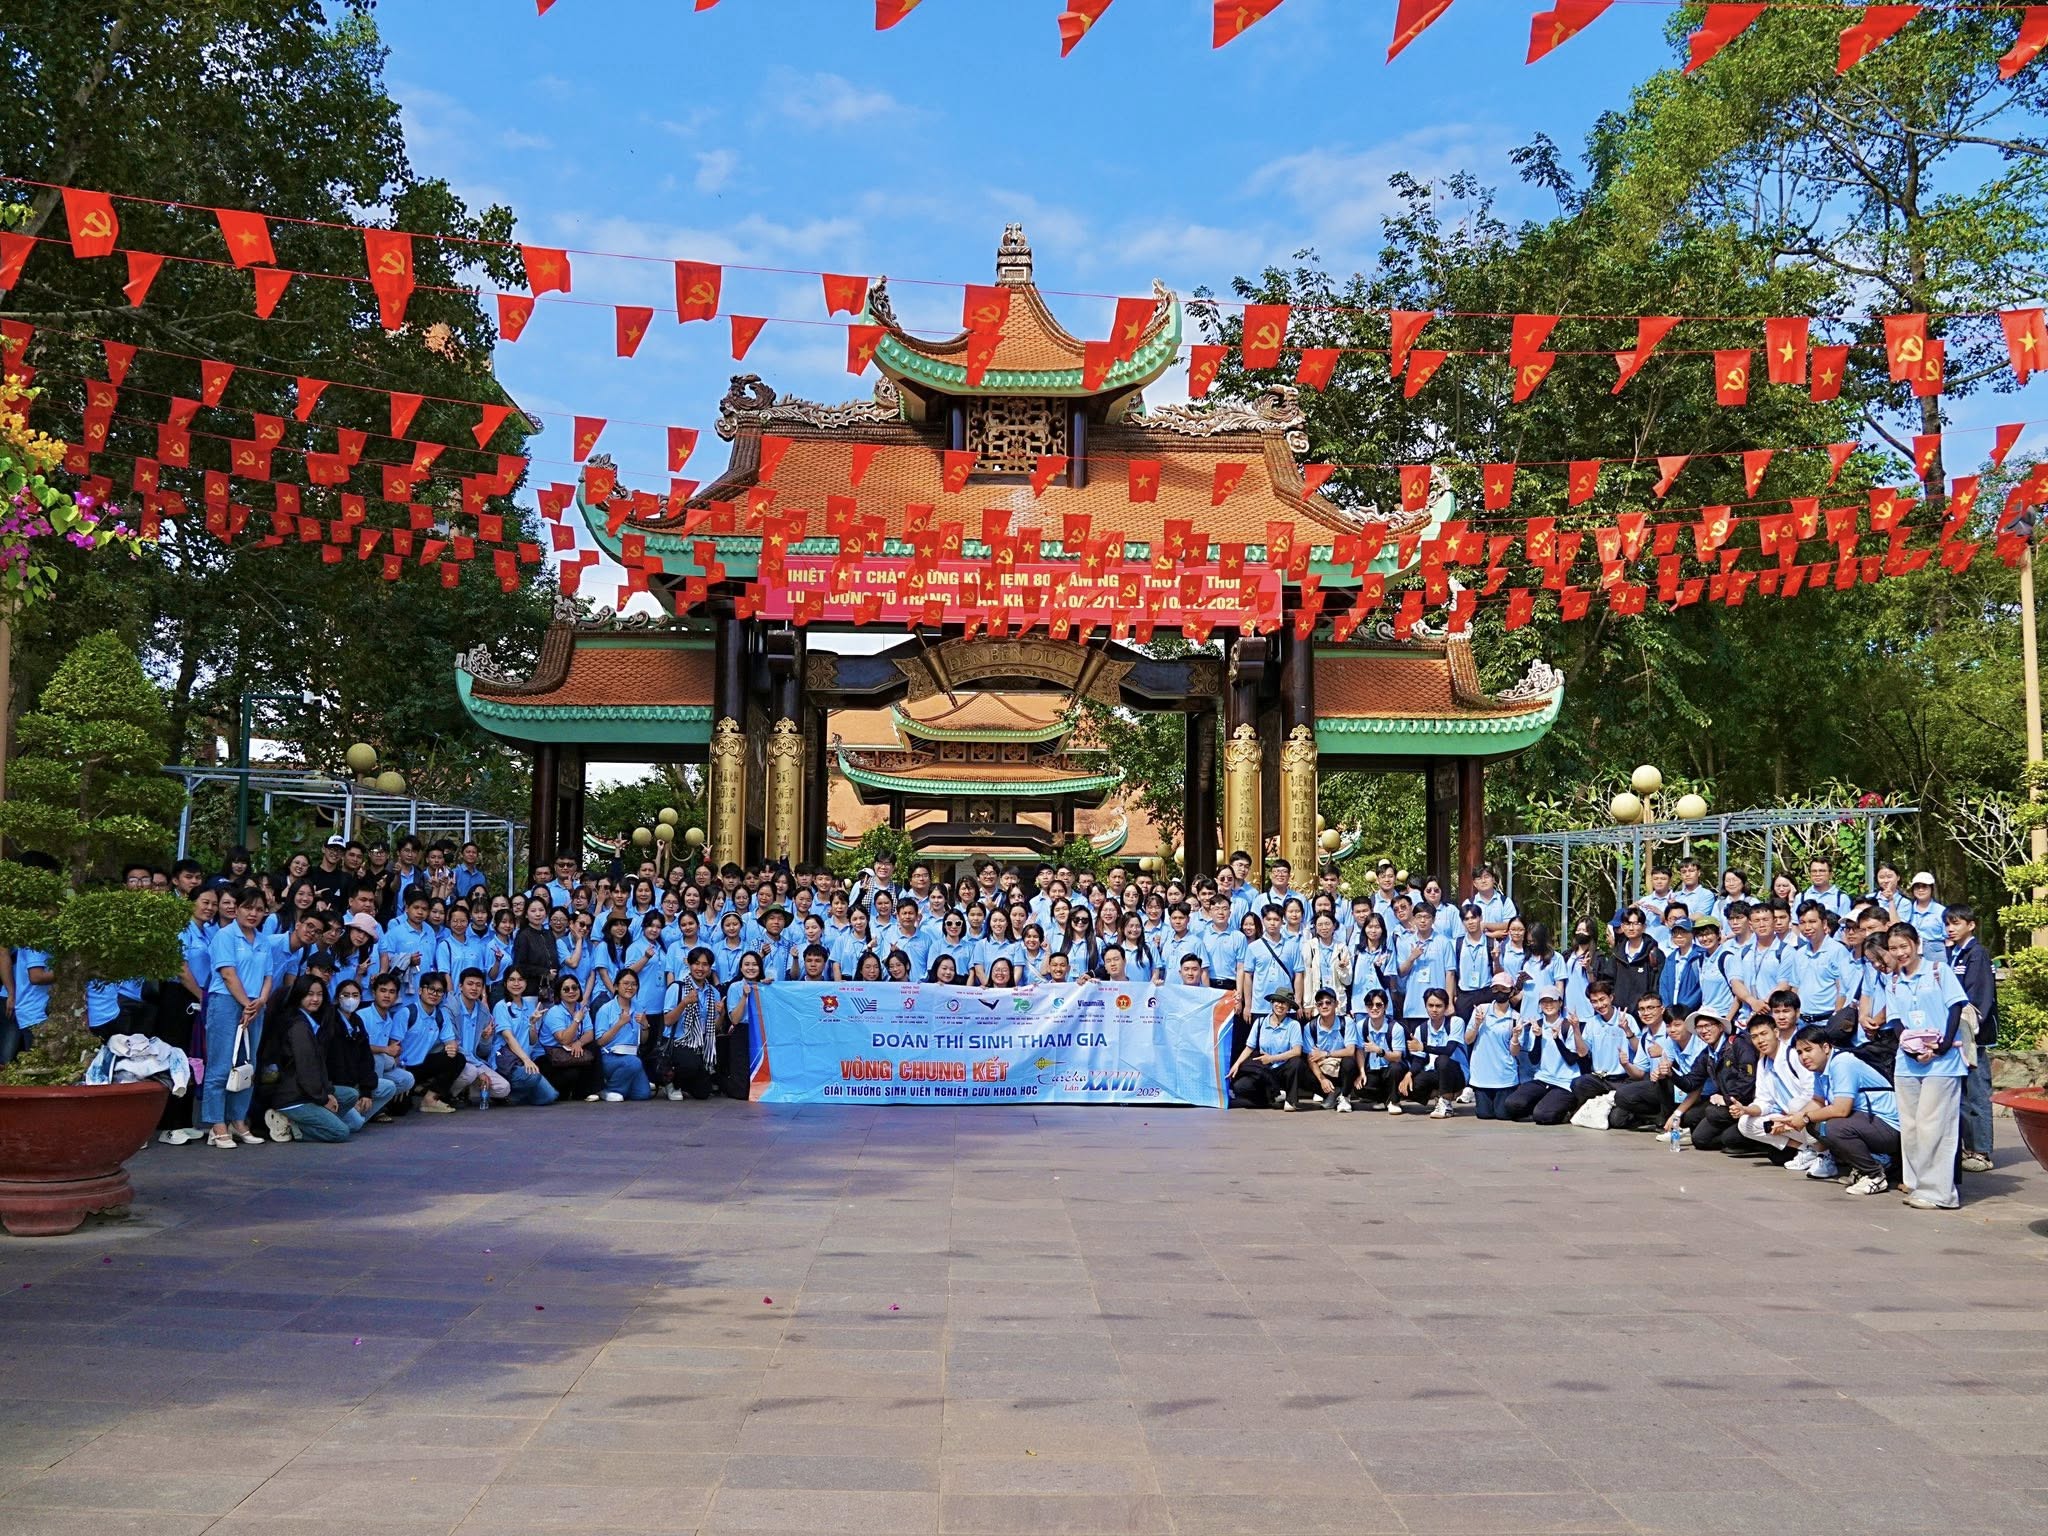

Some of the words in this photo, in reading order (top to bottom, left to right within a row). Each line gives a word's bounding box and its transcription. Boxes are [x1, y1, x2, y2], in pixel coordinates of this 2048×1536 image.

[926, 568, 960, 585] ỪNG
[1000, 572, 1029, 588] IỆM
[1033, 573, 1051, 587] 80
[1040, 594, 1049, 608] 7
[871, 1031, 929, 1049] ĐOÀN
[934, 1032, 964, 1049] THÍ
[968, 1034, 1013, 1049] SINH
[1018, 1033, 1072, 1048] THAM
[1076, 1032, 1108, 1047] GIA
[840, 1056, 893, 1081] VÒNG
[898, 1060, 966, 1082] CHUNG
[971, 1056, 1010, 1083] KẾT
[1081, 1071, 1141, 1091] XXVII
[884, 1086, 907, 1097] SINH
[909, 1084, 931, 1097] VIÊN
[934, 1084, 969, 1097] NGHIÊN
[993, 1087, 1018, 1097] KHOA
[1136, 1087, 1161, 1097] 2025
